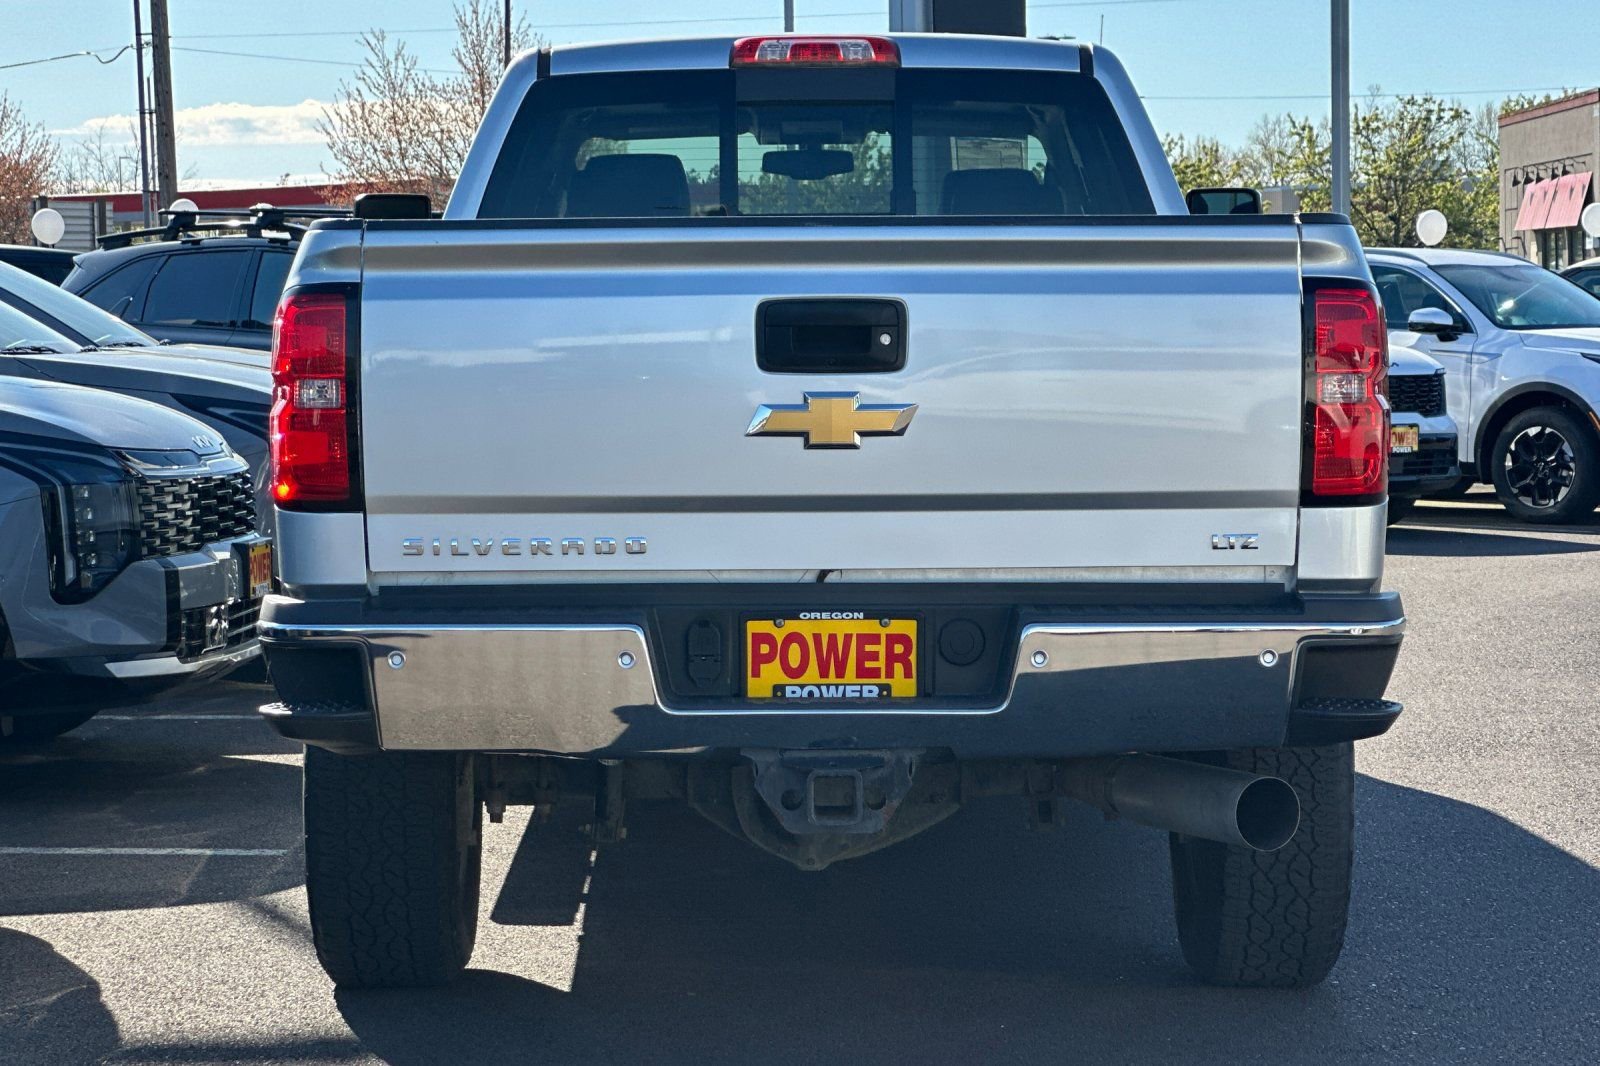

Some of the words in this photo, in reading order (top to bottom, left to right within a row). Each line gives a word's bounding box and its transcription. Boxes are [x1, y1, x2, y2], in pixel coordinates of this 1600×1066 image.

[1392, 431, 1417, 445] OWER
[402, 536, 648, 555] SILVERADO
[1211, 533, 1259, 550] LTZ
[799, 612, 864, 620] OREGON
[751, 631, 914, 680] POWER
[785, 685, 879, 697] POWER
